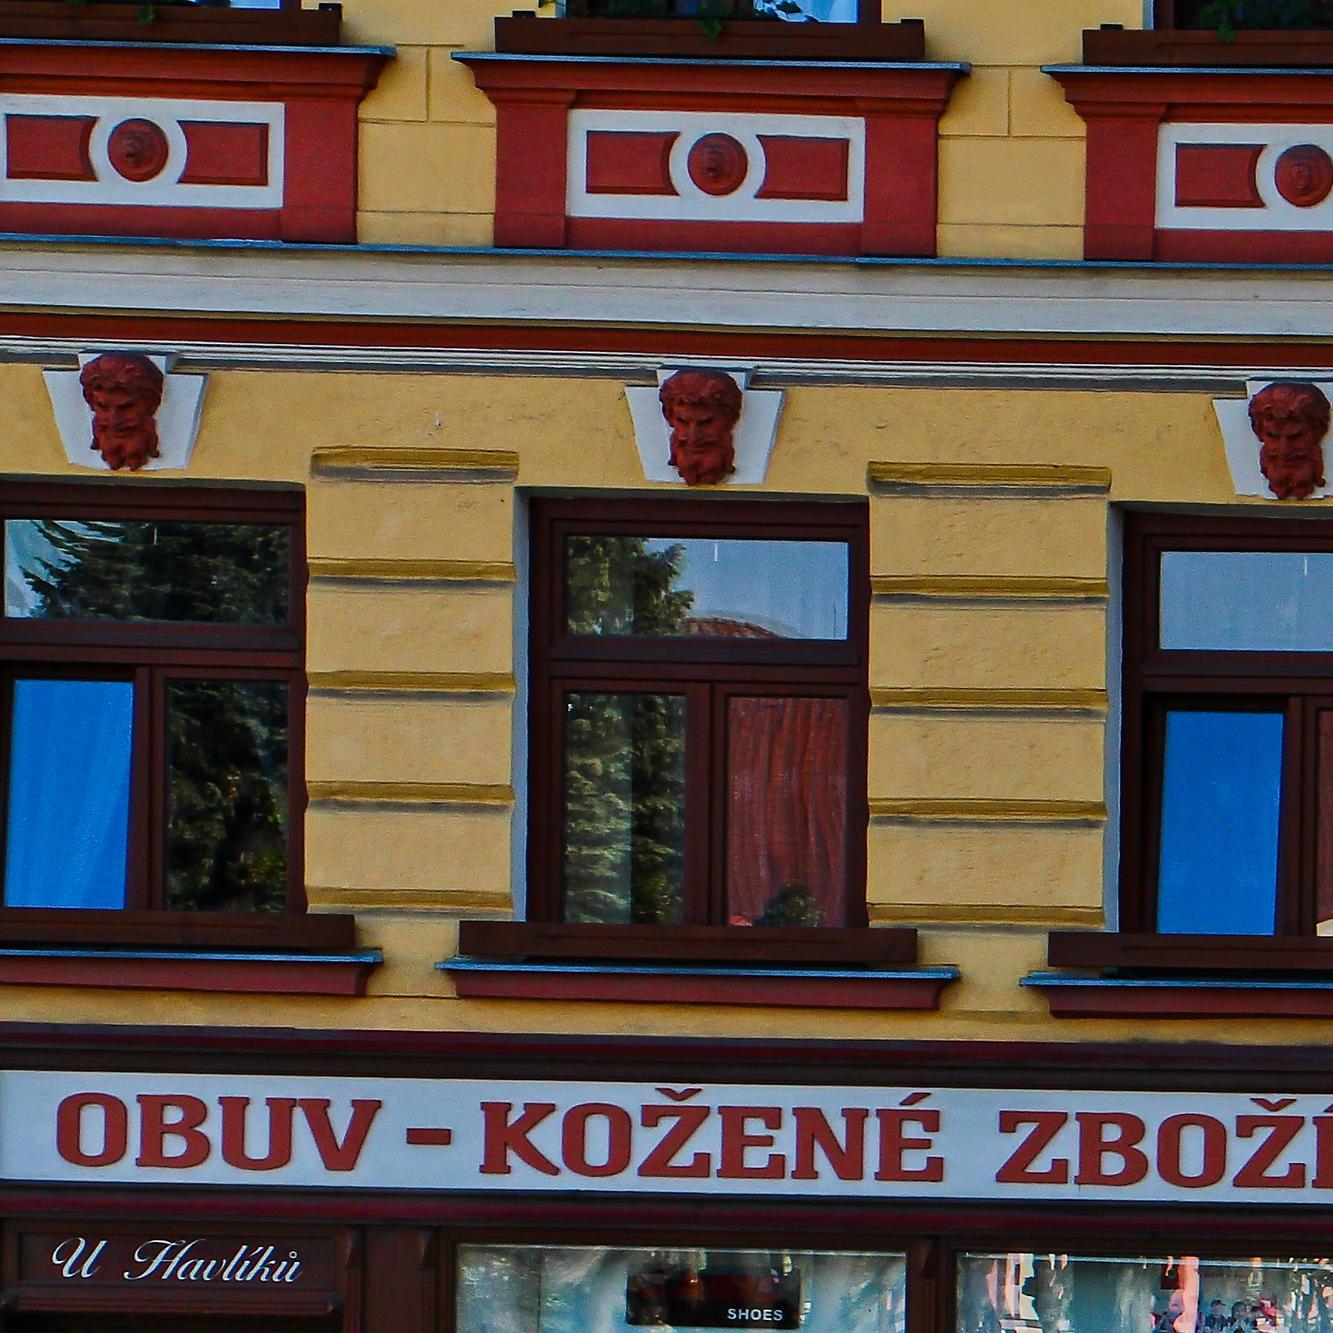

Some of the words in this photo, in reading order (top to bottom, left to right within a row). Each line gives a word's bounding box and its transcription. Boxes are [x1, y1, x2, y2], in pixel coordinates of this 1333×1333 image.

[56, 1092, 382, 1171] OBUV
[479, 1088, 944, 1182] KOŽENÉ
[51, 1237, 107, 1278] U
[123, 1238, 303, 1282] Havlíků
[727, 1308, 783, 1321] SHOES
